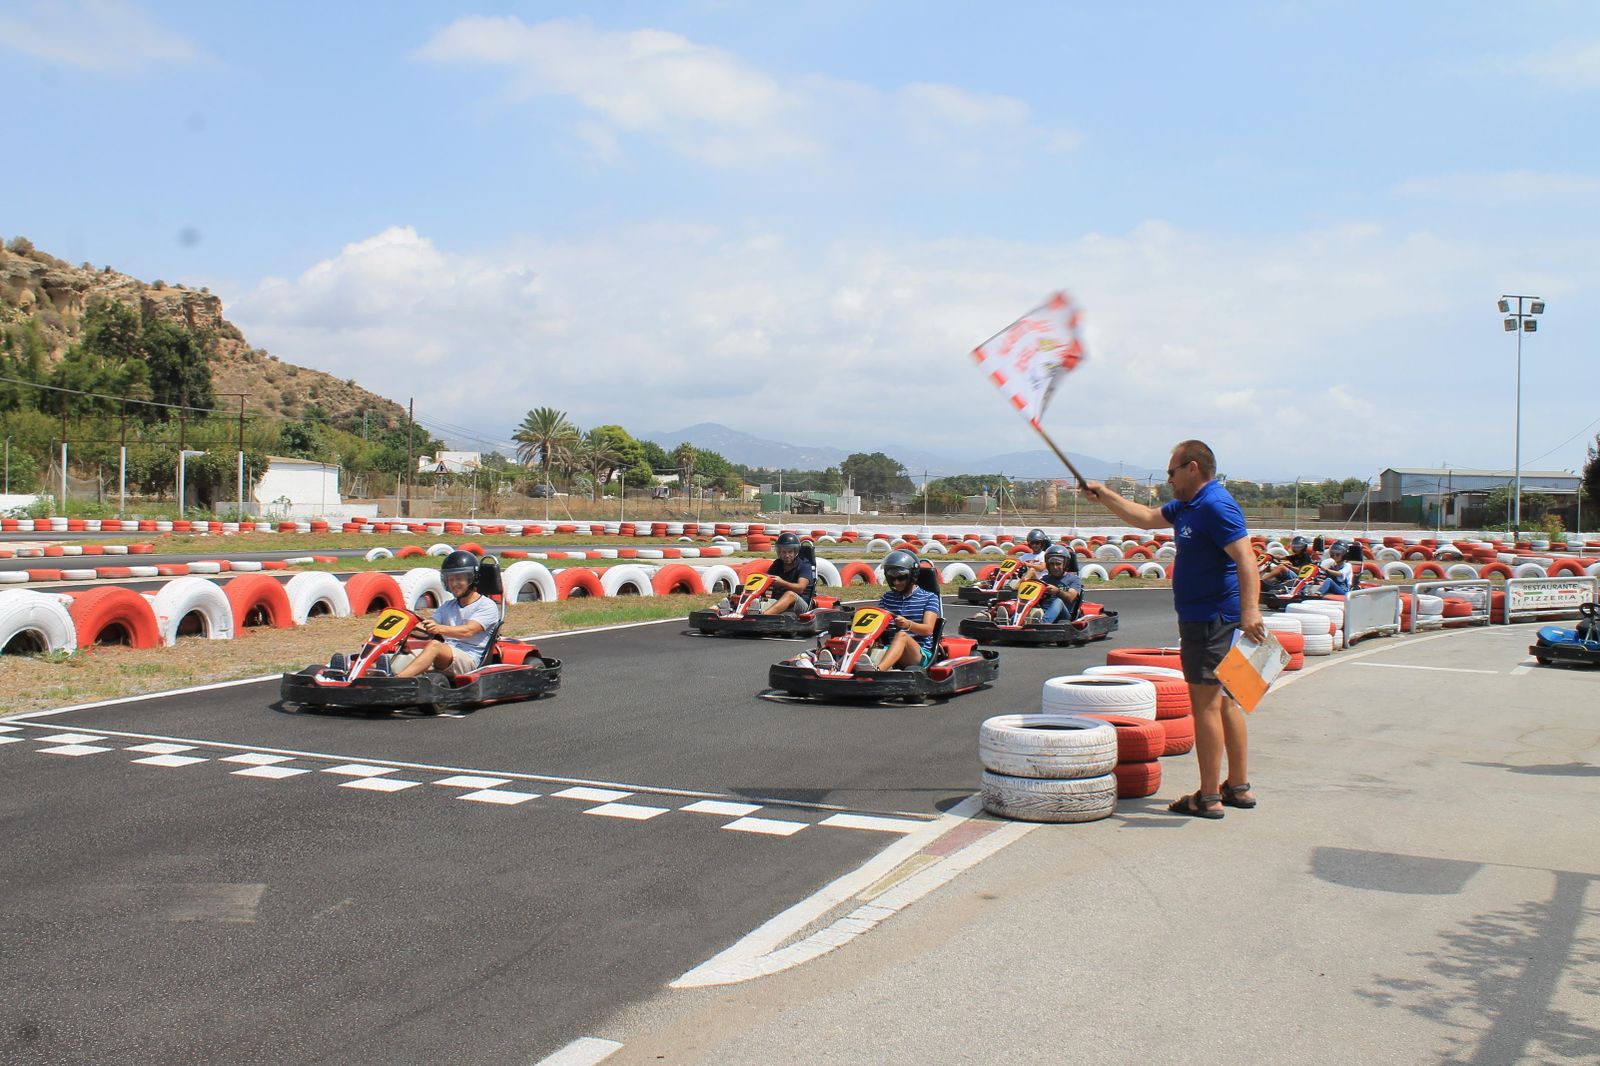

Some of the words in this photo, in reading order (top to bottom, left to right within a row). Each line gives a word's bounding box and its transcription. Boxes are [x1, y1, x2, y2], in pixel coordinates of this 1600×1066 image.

[747, 576, 763, 586] 7
[1020, 585, 1038, 595] 11
[854, 613, 879, 626] 6
